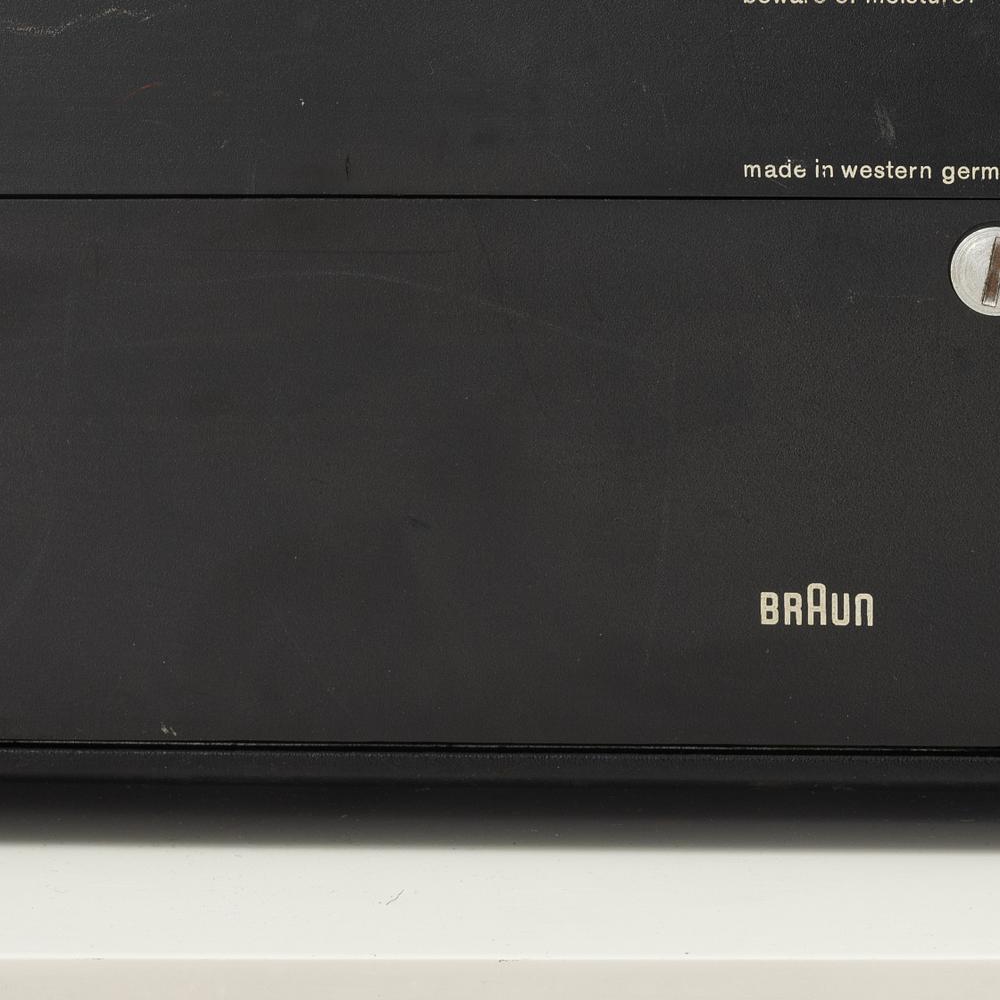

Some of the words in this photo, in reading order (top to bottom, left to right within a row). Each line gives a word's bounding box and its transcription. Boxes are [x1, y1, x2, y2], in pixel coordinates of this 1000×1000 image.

[743, 159, 807, 180] made
[815, 159, 834, 179] in
[840, 160, 932, 180] western
